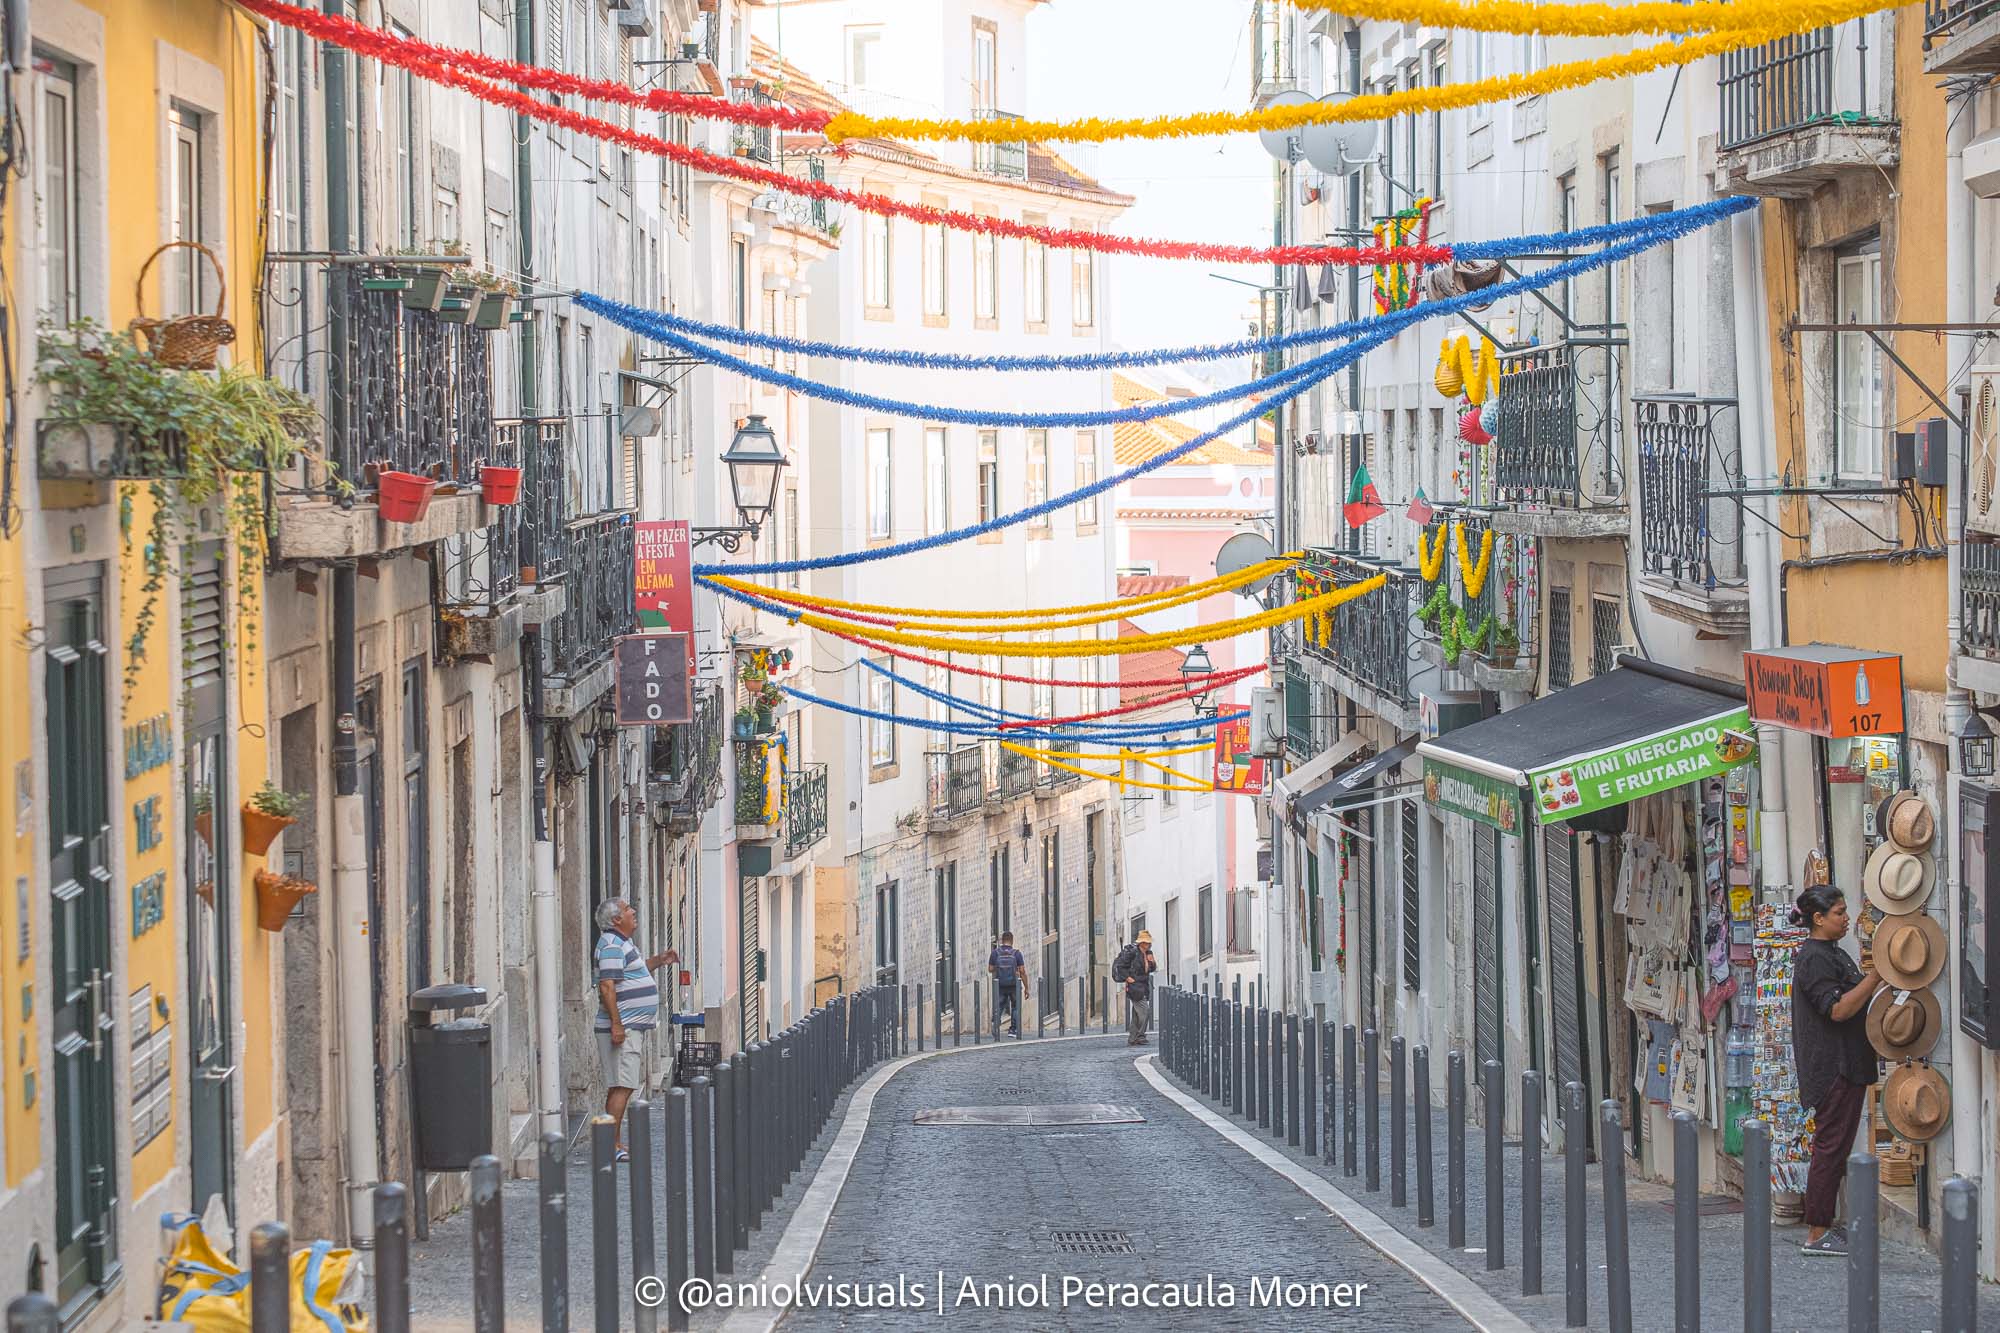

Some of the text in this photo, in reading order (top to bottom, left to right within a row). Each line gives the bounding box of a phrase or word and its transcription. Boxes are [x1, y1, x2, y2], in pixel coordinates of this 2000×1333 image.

[635, 528, 687, 544] VEM FAZER
[638, 543, 675, 560] A FESTA
[641, 560, 656, 575] EM
[636, 574, 674, 590] ALFAMA
[644, 639, 663, 720] FADO
[1756, 658, 1815, 709] Souvenir Shop
[1850, 713, 1882, 733] 107
[1577, 727, 1719, 781] MINI MERCADO
[1597, 753, 1712, 799] E FRUTARIA
[1244, 783, 1262, 791] SAGRES
